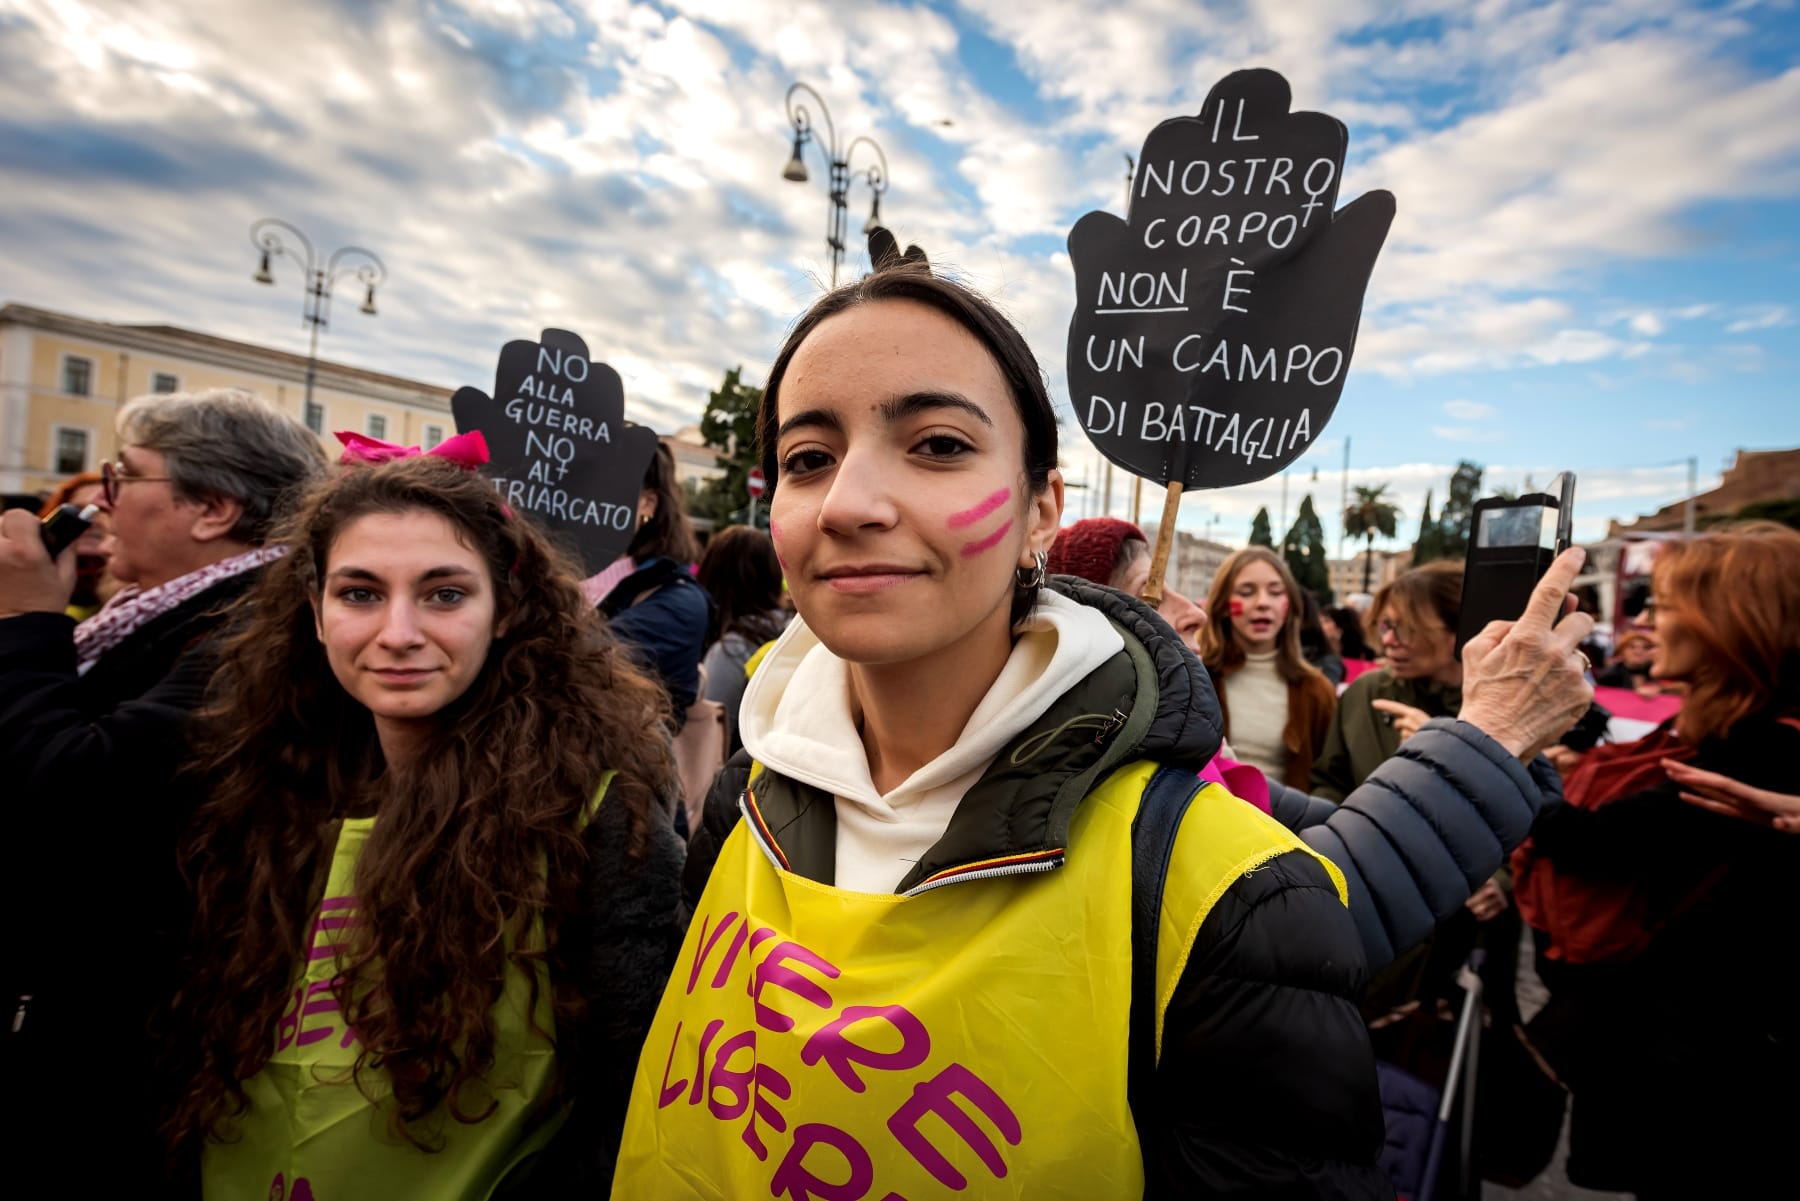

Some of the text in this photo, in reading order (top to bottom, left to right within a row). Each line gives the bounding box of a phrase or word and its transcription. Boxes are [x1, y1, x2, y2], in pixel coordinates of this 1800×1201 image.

[1211, 98, 1259, 143] IL
[1141, 157, 1336, 199] NOSTRO
[1144, 211, 1297, 249] CORPO
[1097, 258, 1255, 313] NON È
[536, 346, 589, 383] NO
[1086, 334, 1343, 386] UN CAMPO
[518, 375, 575, 408] ALLA
[504, 398, 611, 443] GUERRA
[1086, 395, 1311, 465] DI BATTAGLIA
[524, 429, 576, 464] NO
[527, 459, 556, 487] AL
[490, 477, 632, 531] TRIARCATO
[658, 1018, 910, 1201] LIBER
